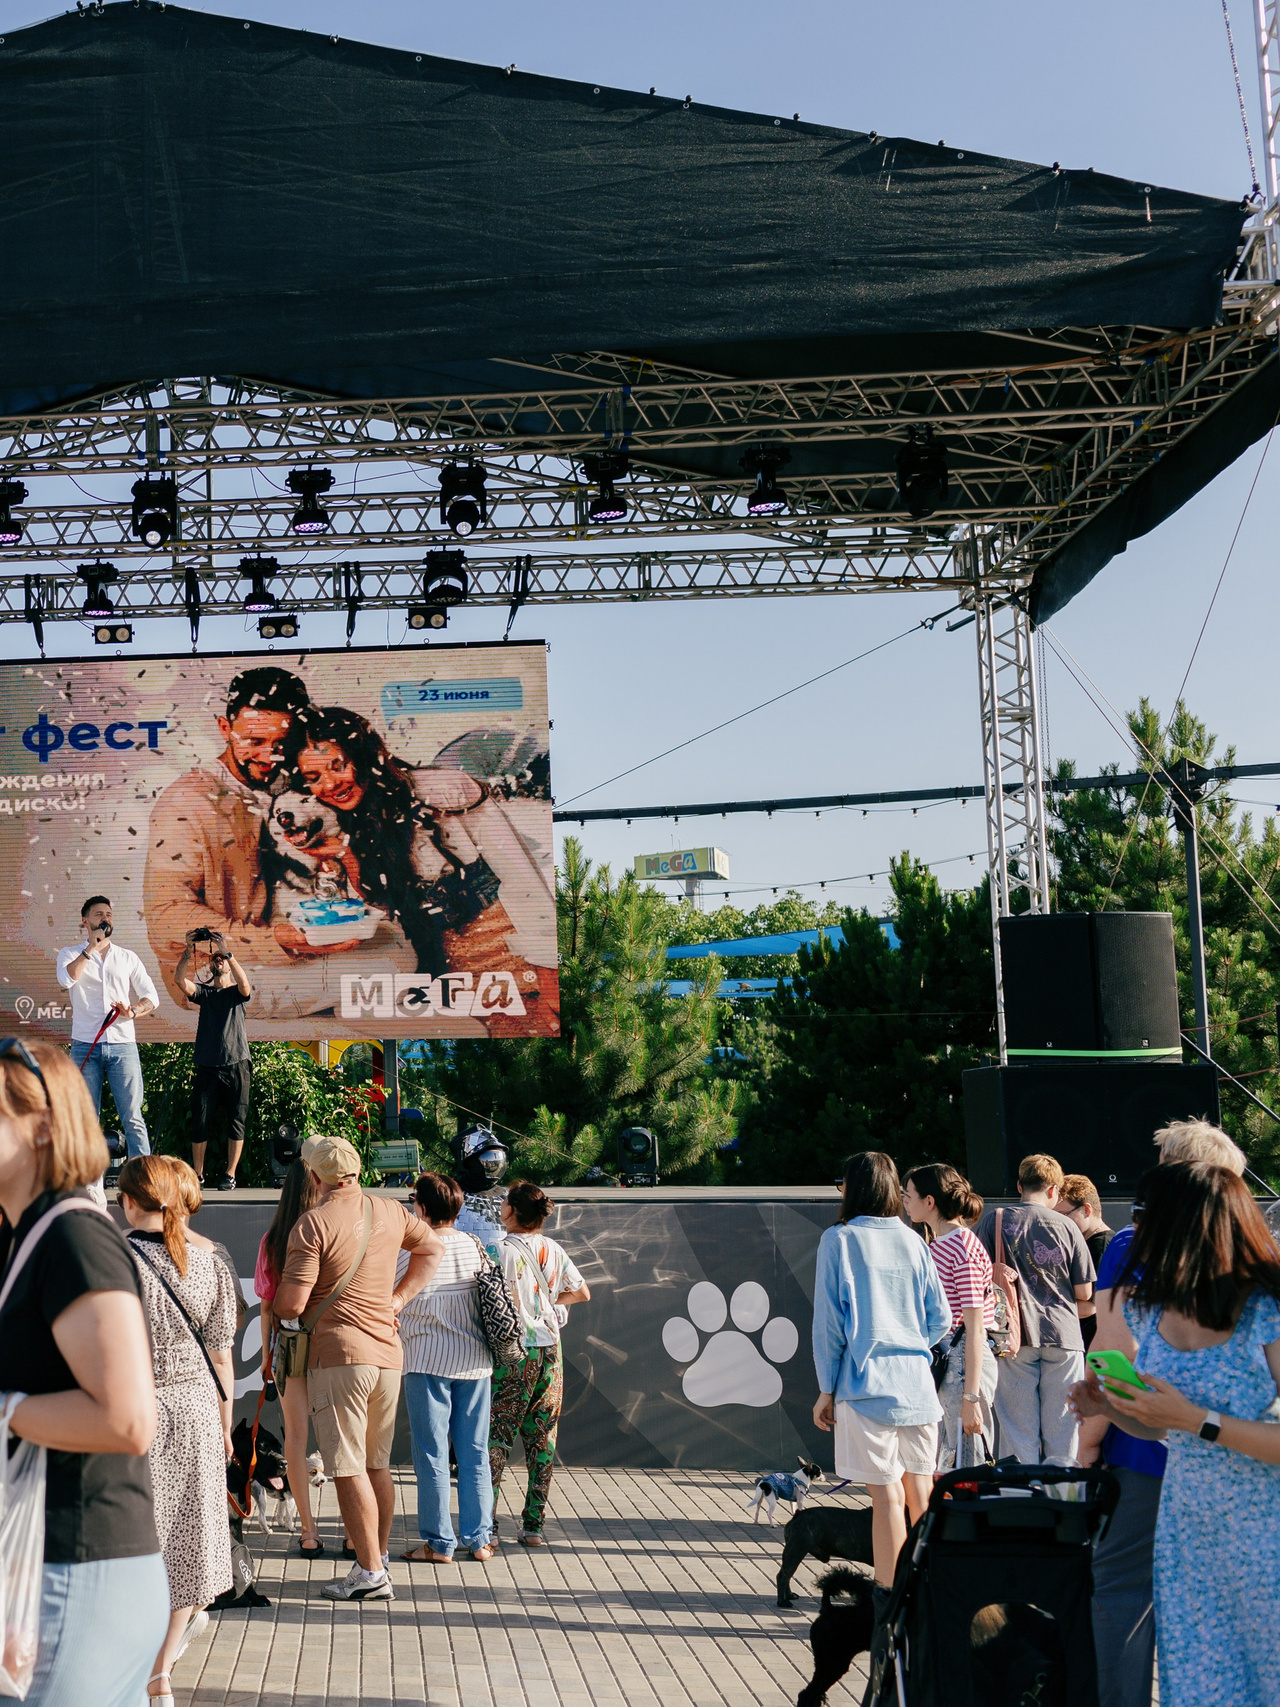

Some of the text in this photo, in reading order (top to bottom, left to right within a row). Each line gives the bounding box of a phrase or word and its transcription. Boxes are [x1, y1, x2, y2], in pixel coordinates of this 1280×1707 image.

[418, 690, 489, 701] 23 июня
[22, 713, 168, 763] фест
[37, 1007, 74, 1019] МЕГ
